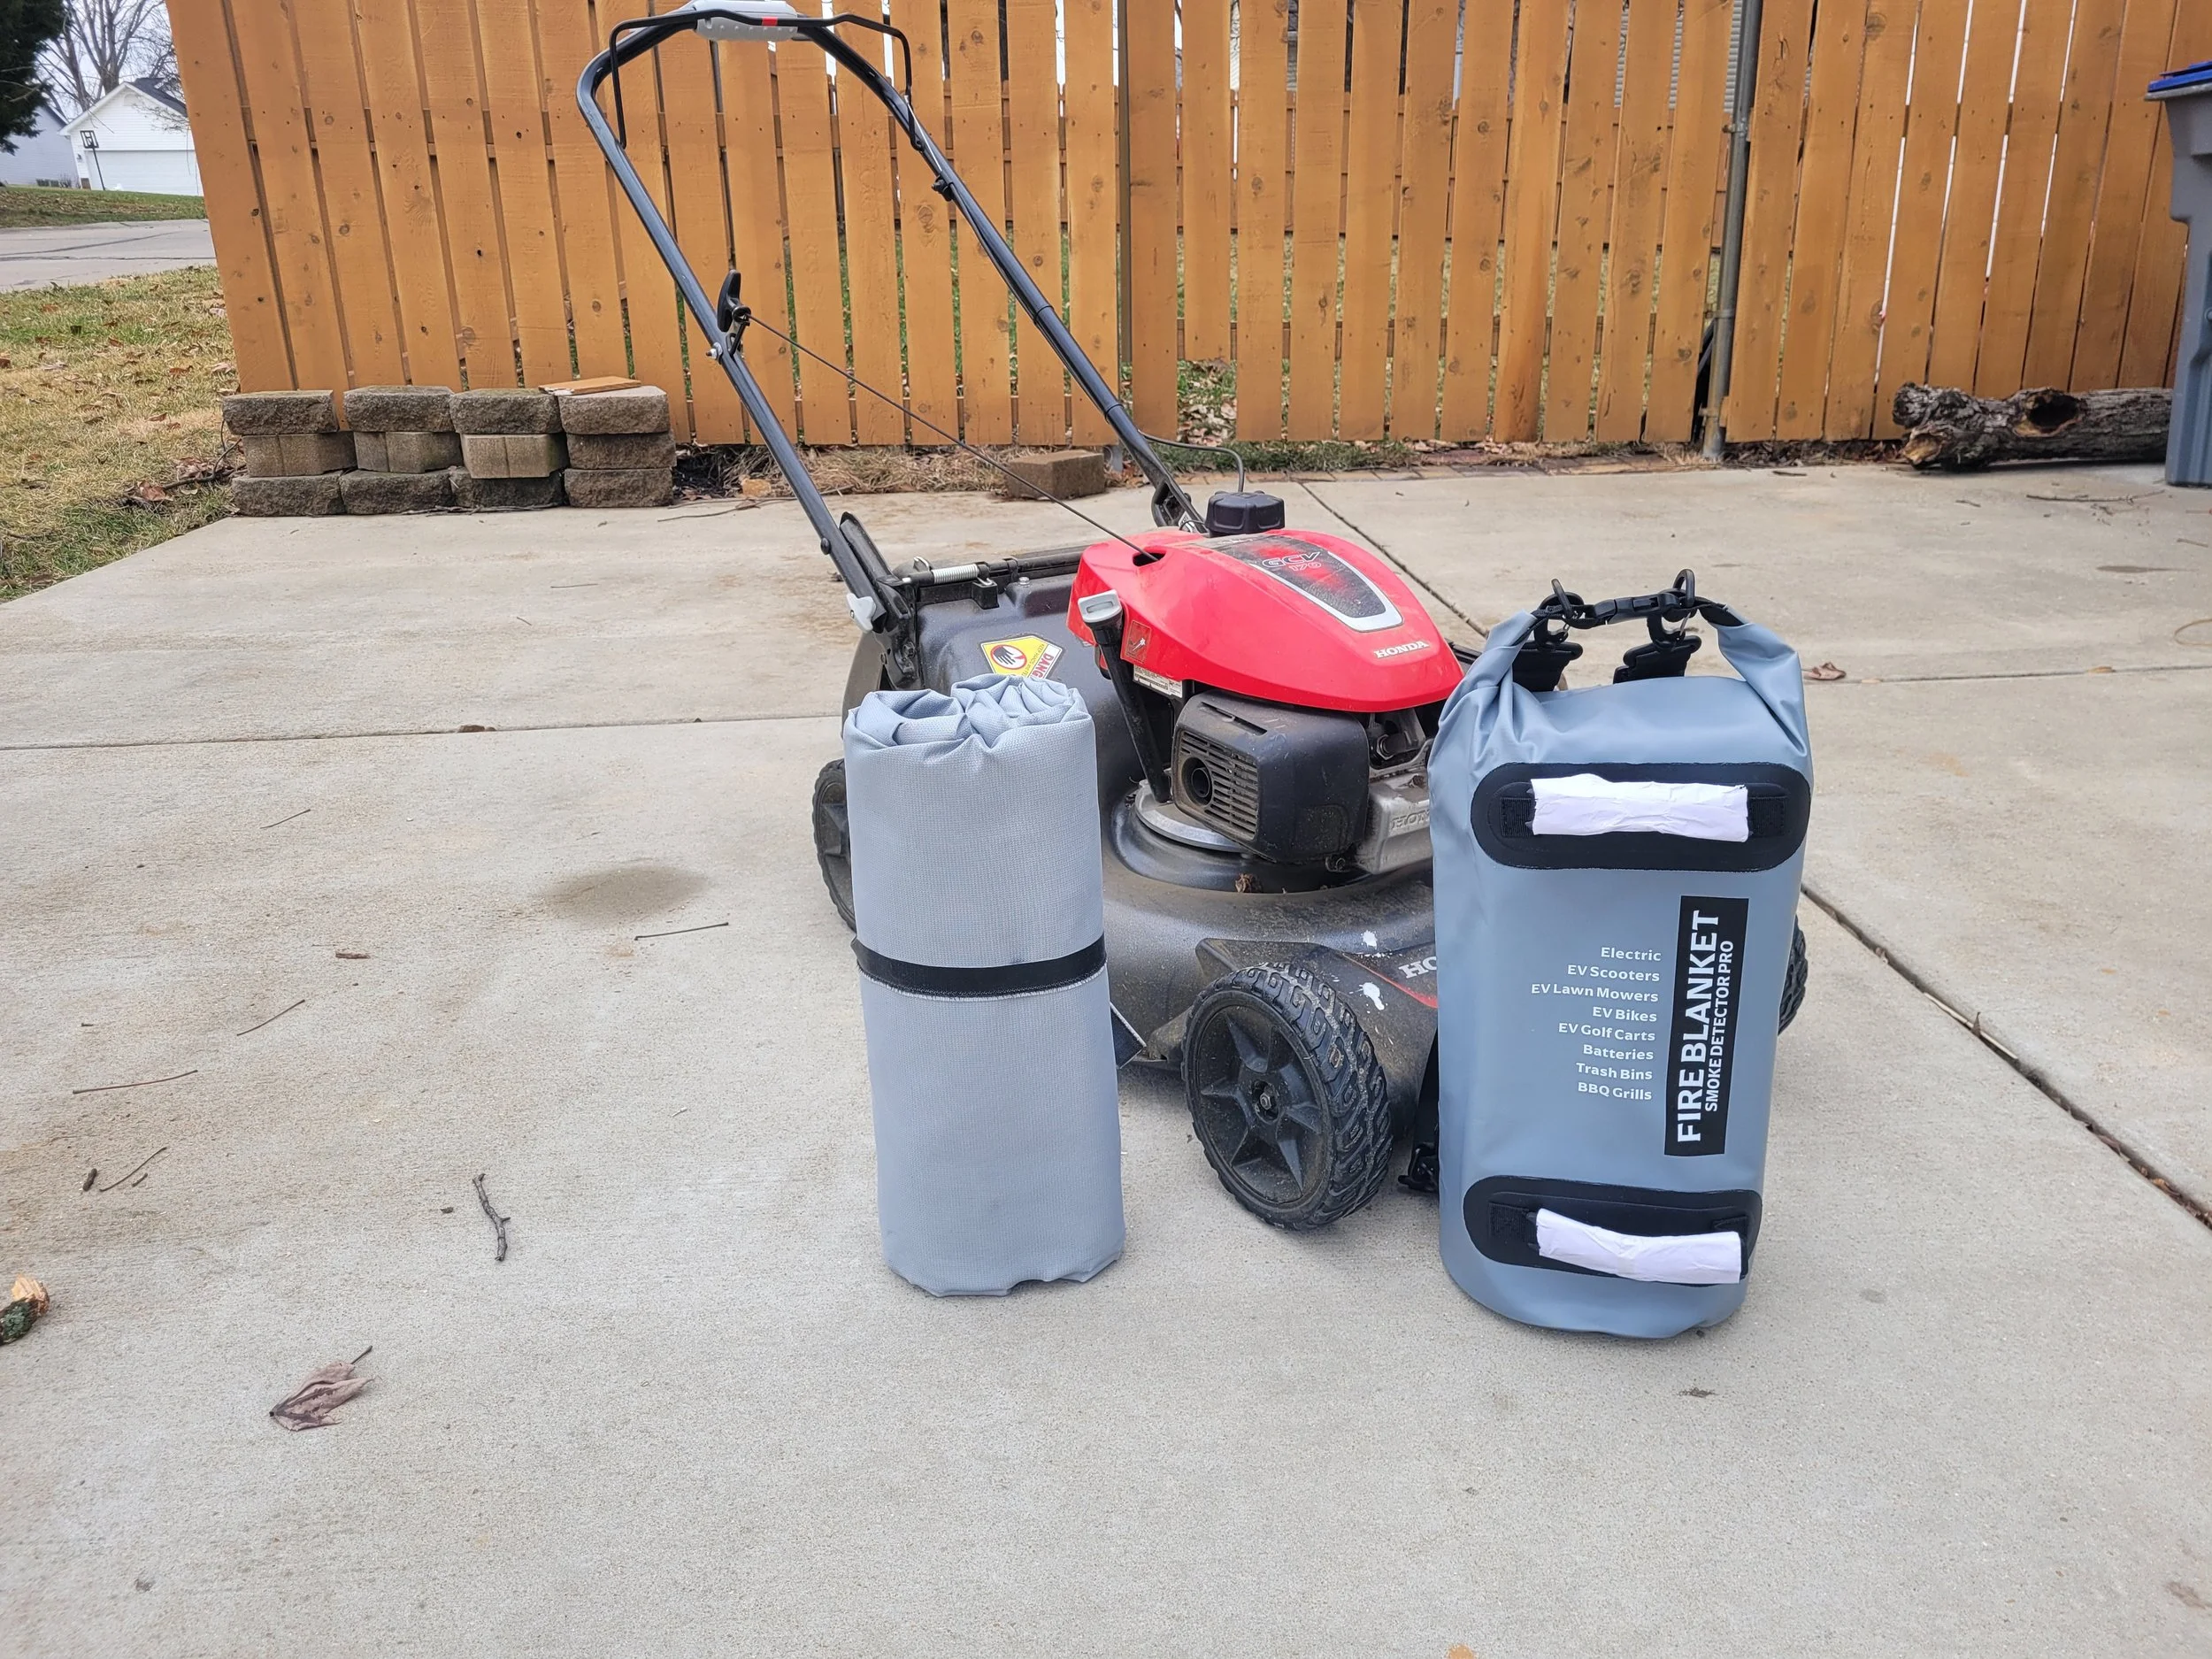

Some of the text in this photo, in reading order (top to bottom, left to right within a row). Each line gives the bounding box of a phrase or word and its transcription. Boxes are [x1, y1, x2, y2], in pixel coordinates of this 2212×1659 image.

[1262, 551, 1321, 568] GCV
[1288, 561, 1322, 572] 170
[1373, 641, 1430, 658] HONDA
[1030, 652, 1055, 679] DANG
[1390, 809, 1431, 830] HON
[1601, 947, 1662, 962] Electric
[1567, 964, 1660, 982] EV Scooters
[1531, 983, 1659, 1002] EV Lawn Mowers
[1592, 1006, 1657, 1023] EV Bikes
[1558, 1022, 1655, 1041] EV Golf Carts
[1677, 910, 1719, 1142] FIRE BLANKET
[1704, 941, 1734, 1112] SMOKE DETECTOR PRO
[1583, 1043, 1654, 1060] Batteries
[1575, 1062, 1653, 1080] Trash Bins
[1578, 1081, 1652, 1101] BBQ Grills
